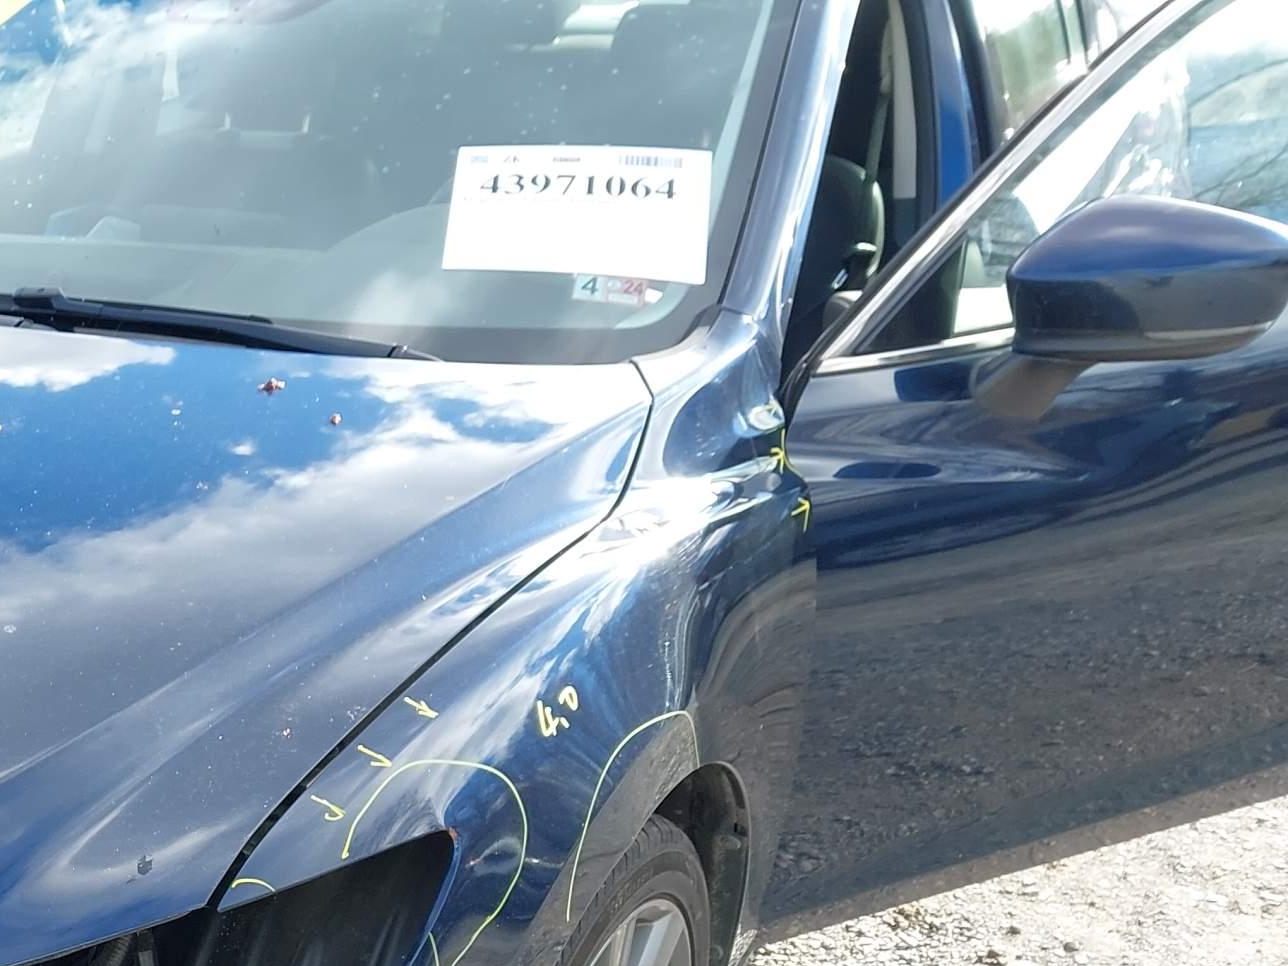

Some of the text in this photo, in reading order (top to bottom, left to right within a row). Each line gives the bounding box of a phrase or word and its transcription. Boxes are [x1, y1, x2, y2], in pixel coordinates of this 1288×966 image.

[480, 174, 677, 199] 43971064
[581, 276, 643, 297] 4 24
